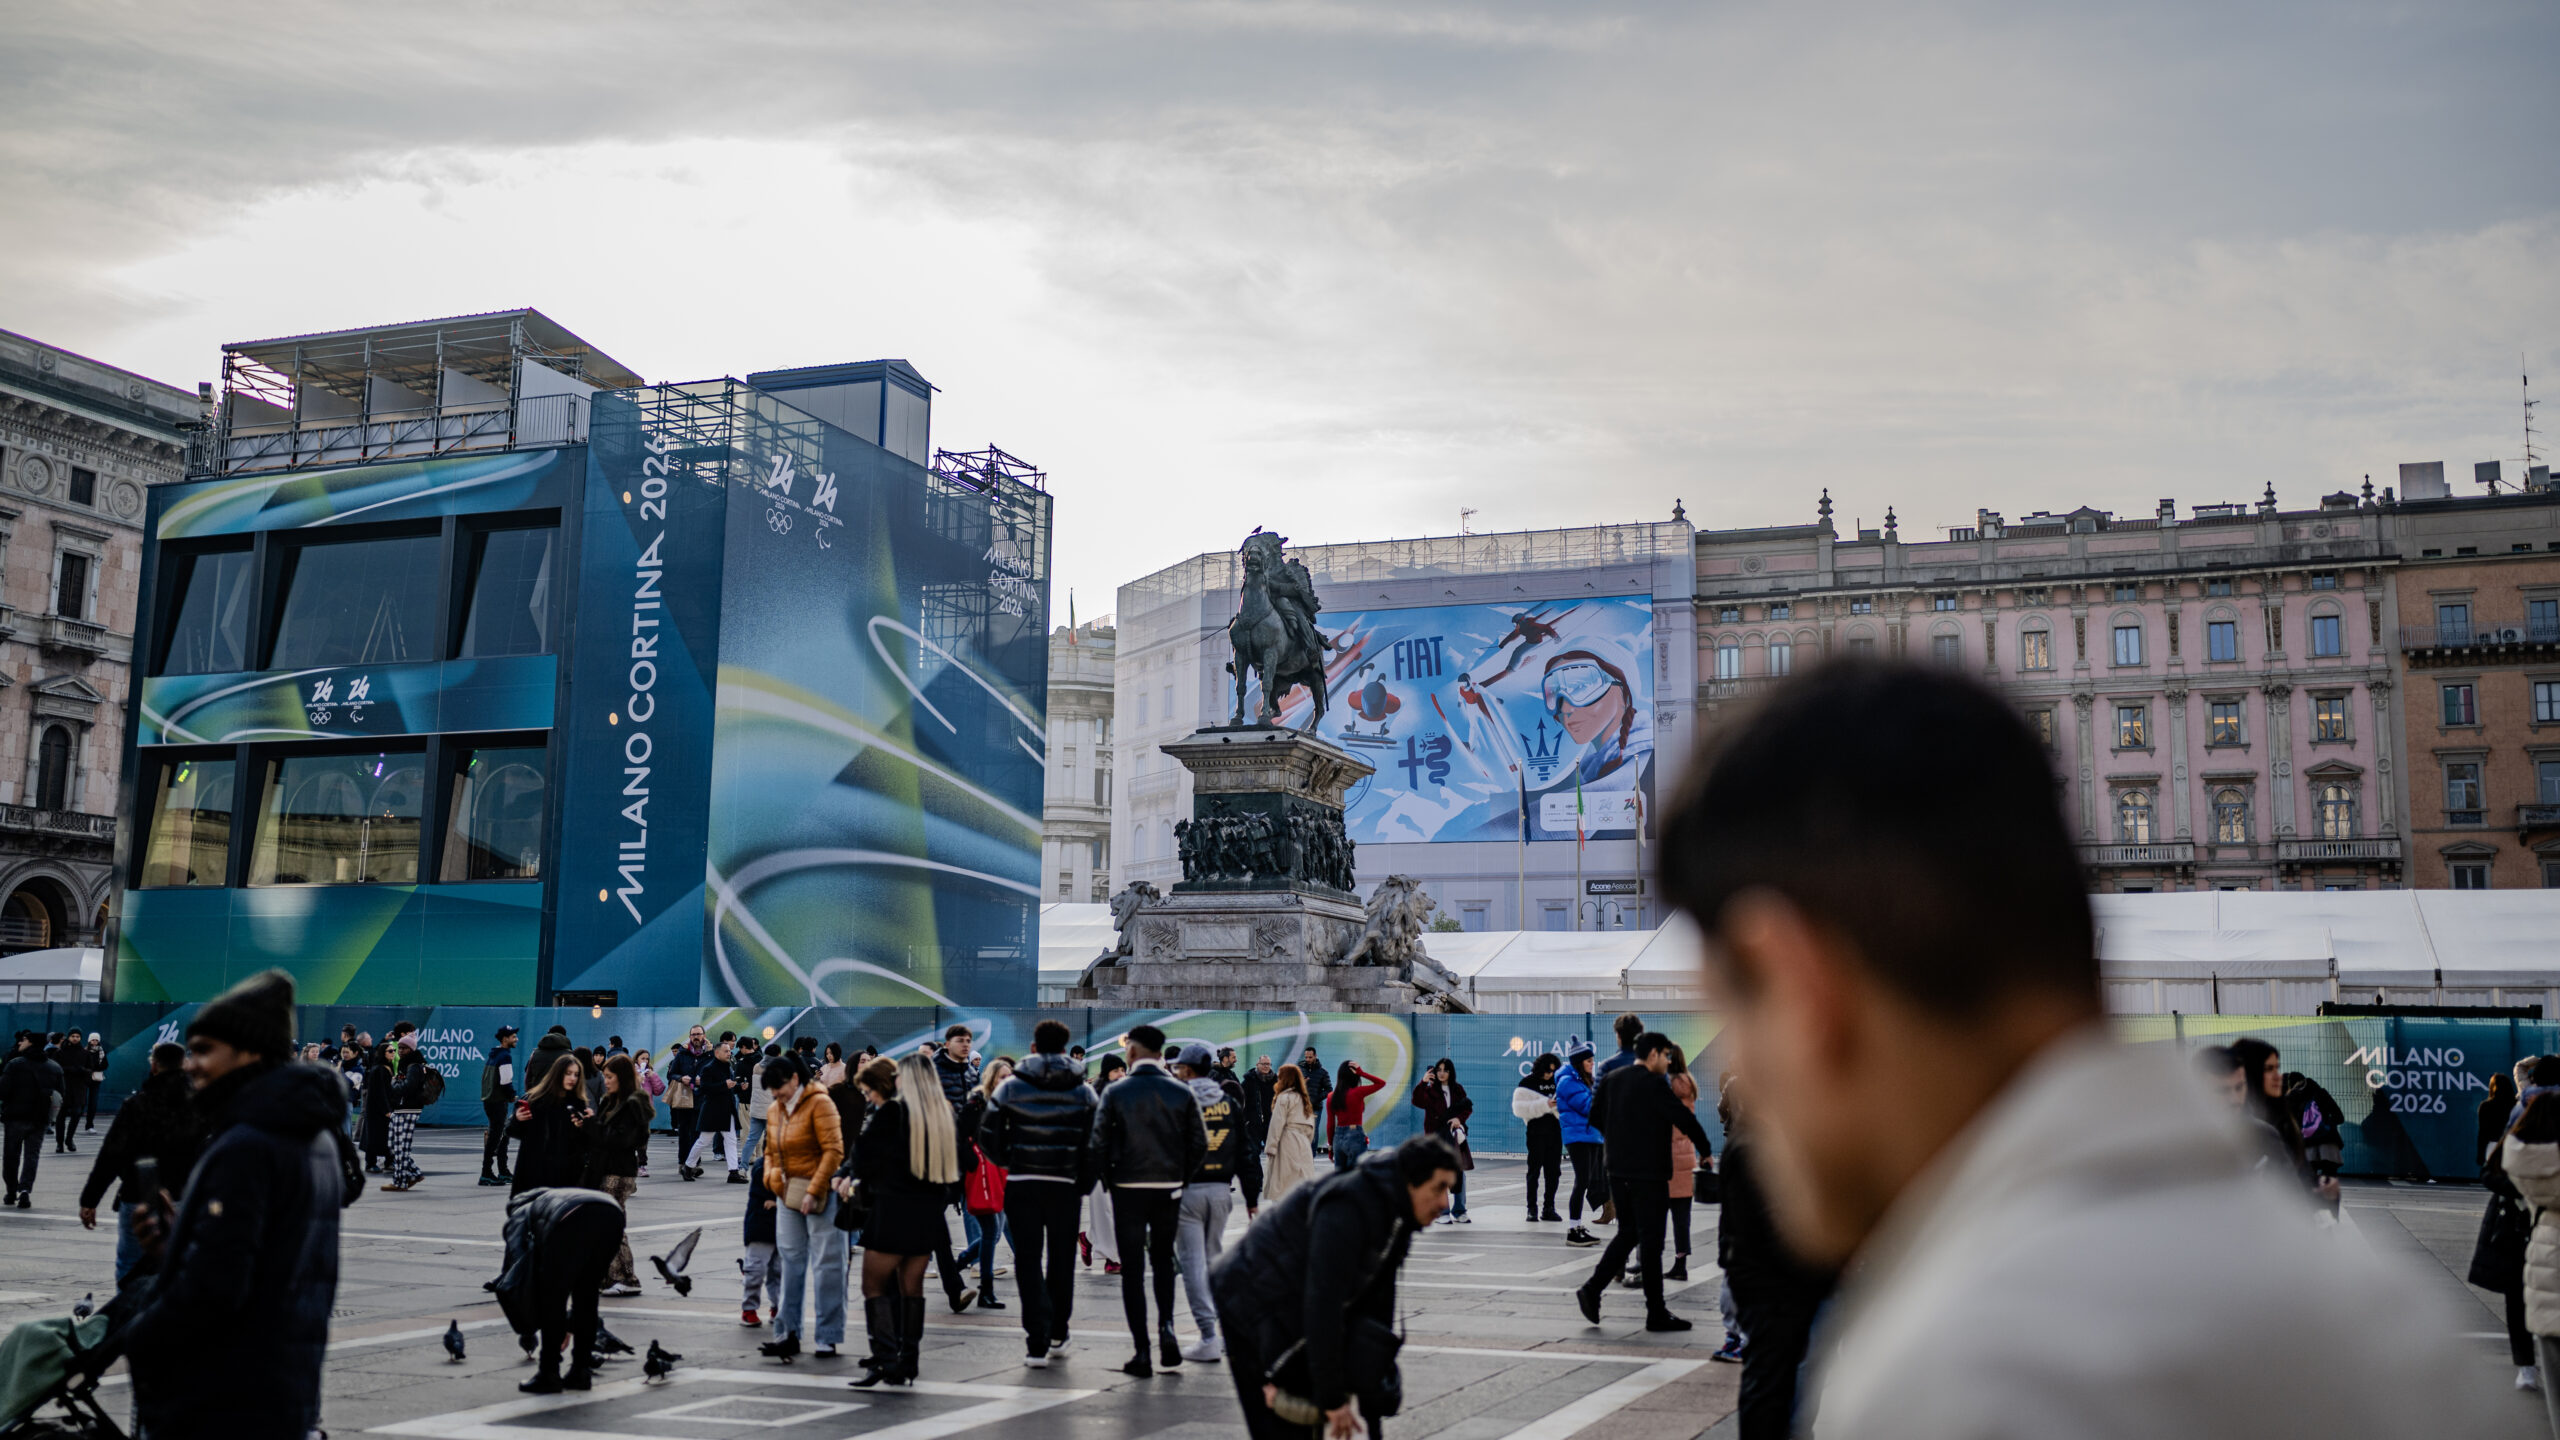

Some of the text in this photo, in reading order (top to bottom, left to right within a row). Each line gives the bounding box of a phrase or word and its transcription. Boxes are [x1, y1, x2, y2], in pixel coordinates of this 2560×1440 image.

[983, 546, 1031, 578] MILANO
[991, 570, 1039, 604] CORTINA
[1000, 594, 1022, 617] 2026
[1394, 636, 1443, 681] FIAT
[616, 432, 670, 925] MILANO CORTINA 2026
[2344, 1046, 2464, 1067] MILANO
[2365, 1069, 2491, 1091] CORTINA
[2389, 1093, 2447, 1114] 2026
